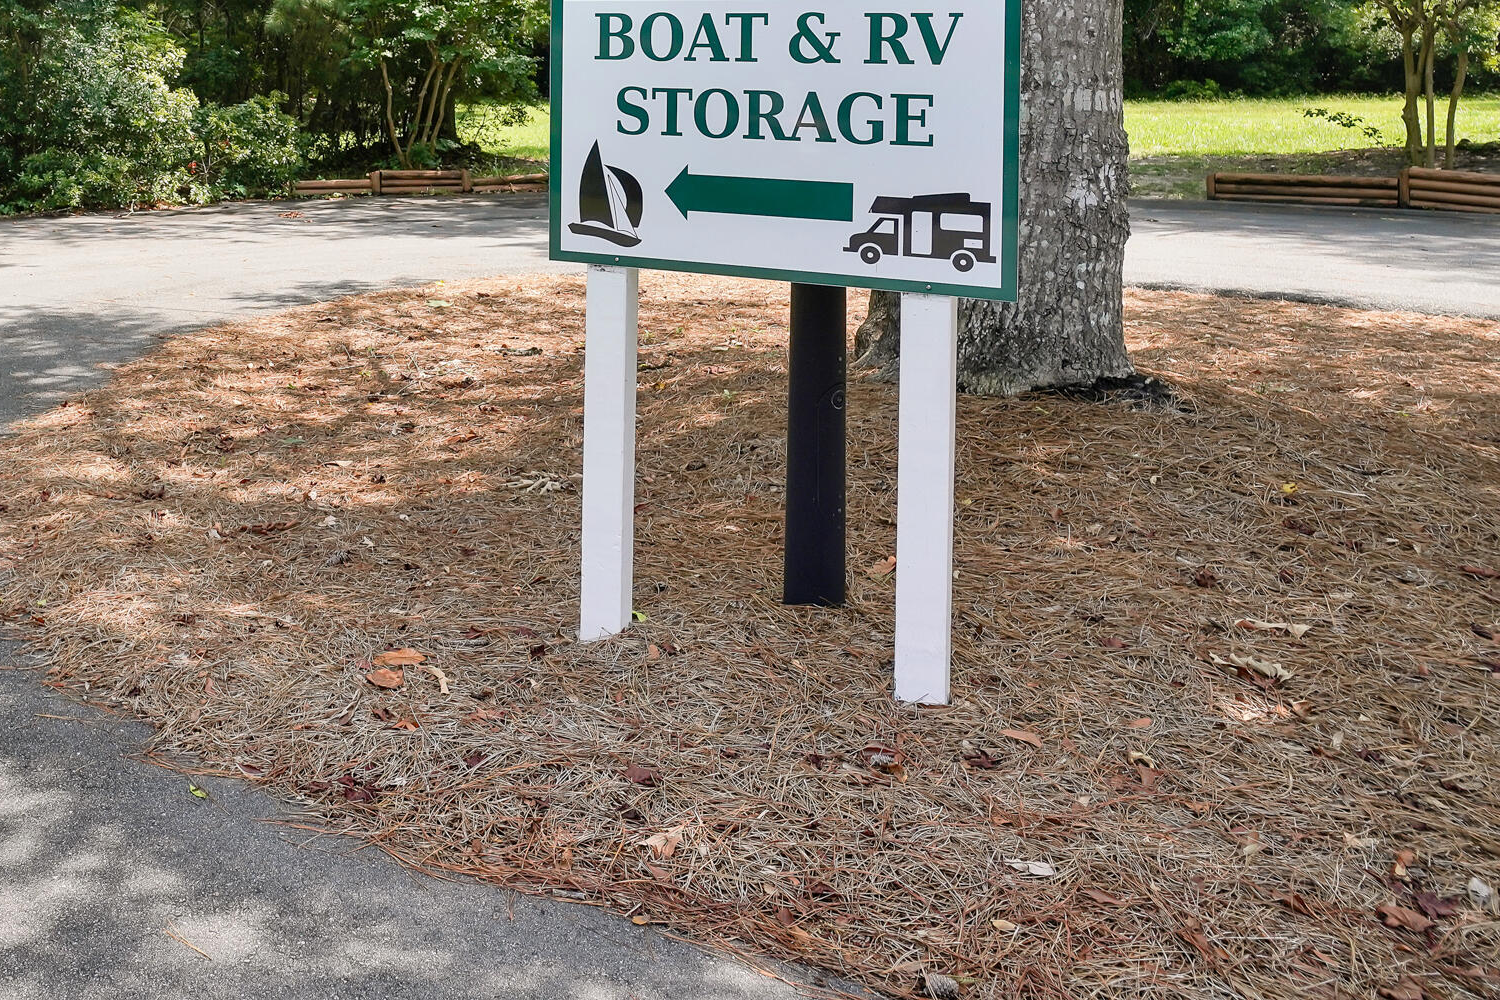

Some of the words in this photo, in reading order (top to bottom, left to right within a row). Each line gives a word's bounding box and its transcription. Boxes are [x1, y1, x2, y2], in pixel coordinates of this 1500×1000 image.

[594, 11, 769, 63] BOAT
[788, 11, 842, 65] &
[863, 11, 964, 66] RV
[615, 85, 935, 147] STORAGE
